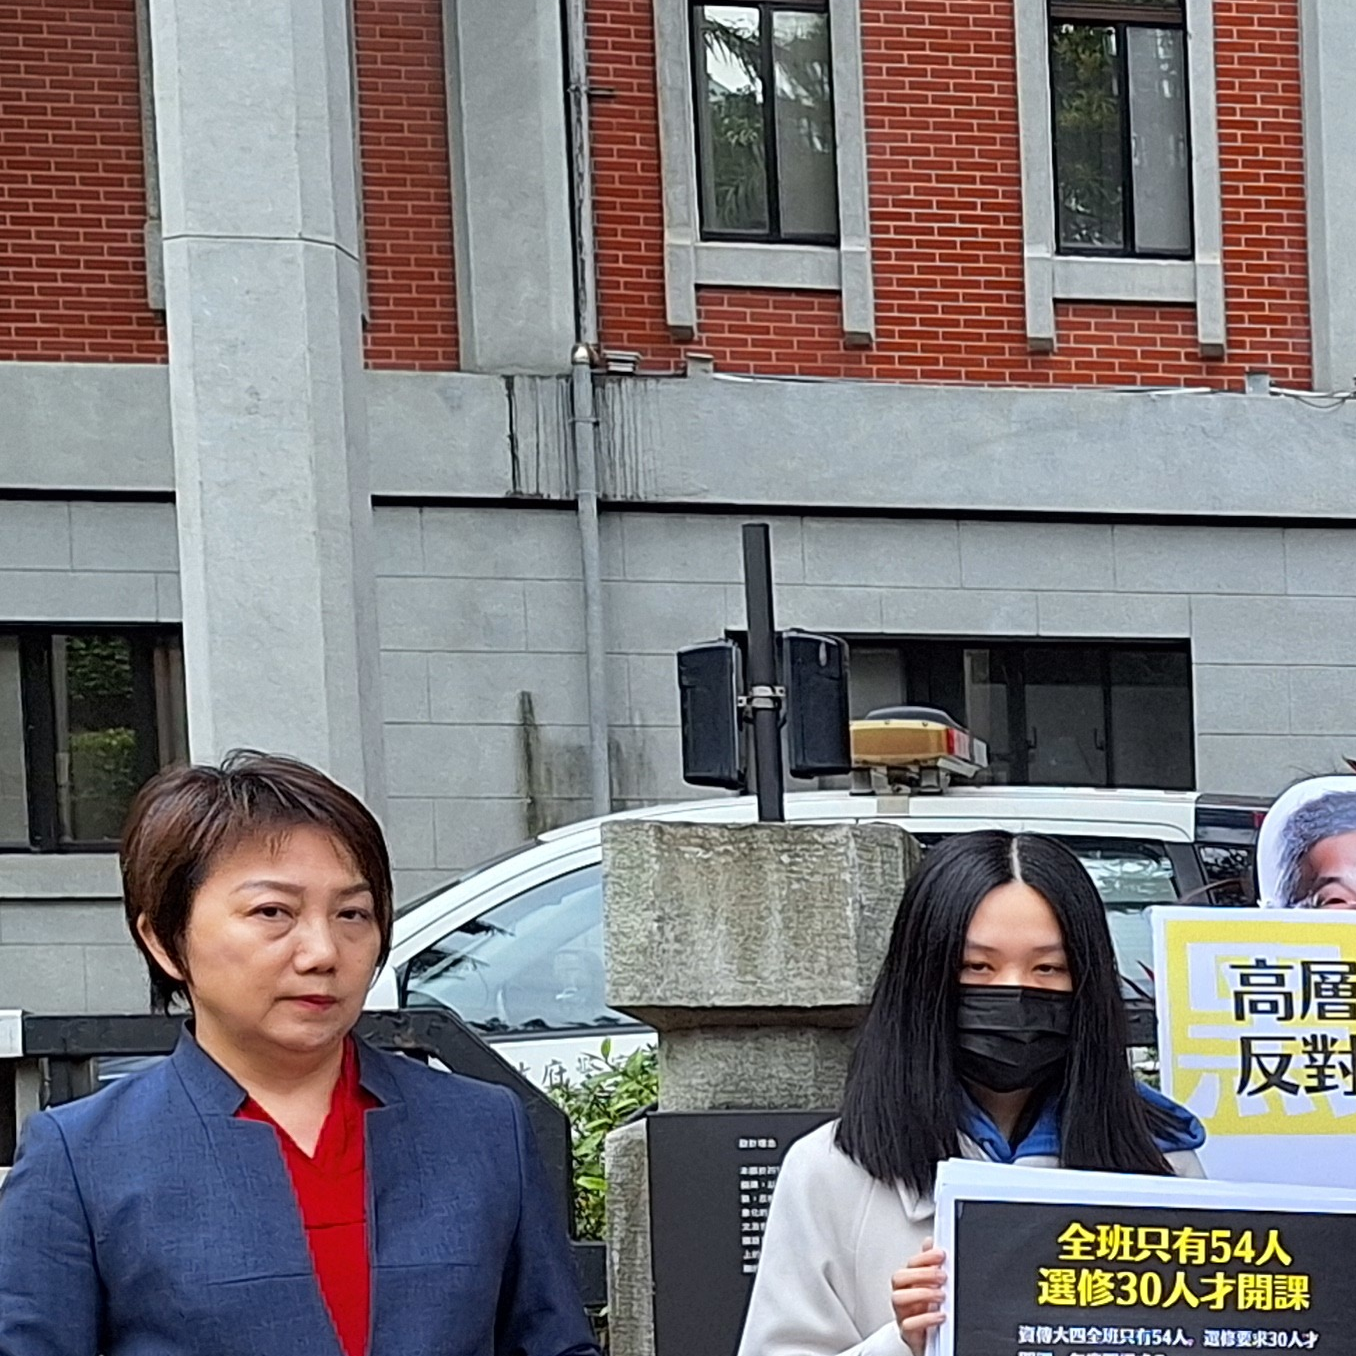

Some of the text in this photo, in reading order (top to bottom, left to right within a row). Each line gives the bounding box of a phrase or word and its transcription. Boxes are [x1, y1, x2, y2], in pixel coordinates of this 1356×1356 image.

[1057, 1223, 1292, 1266] 全班只有54人
[1038, 1267, 1310, 1311] 選修30人才開課
